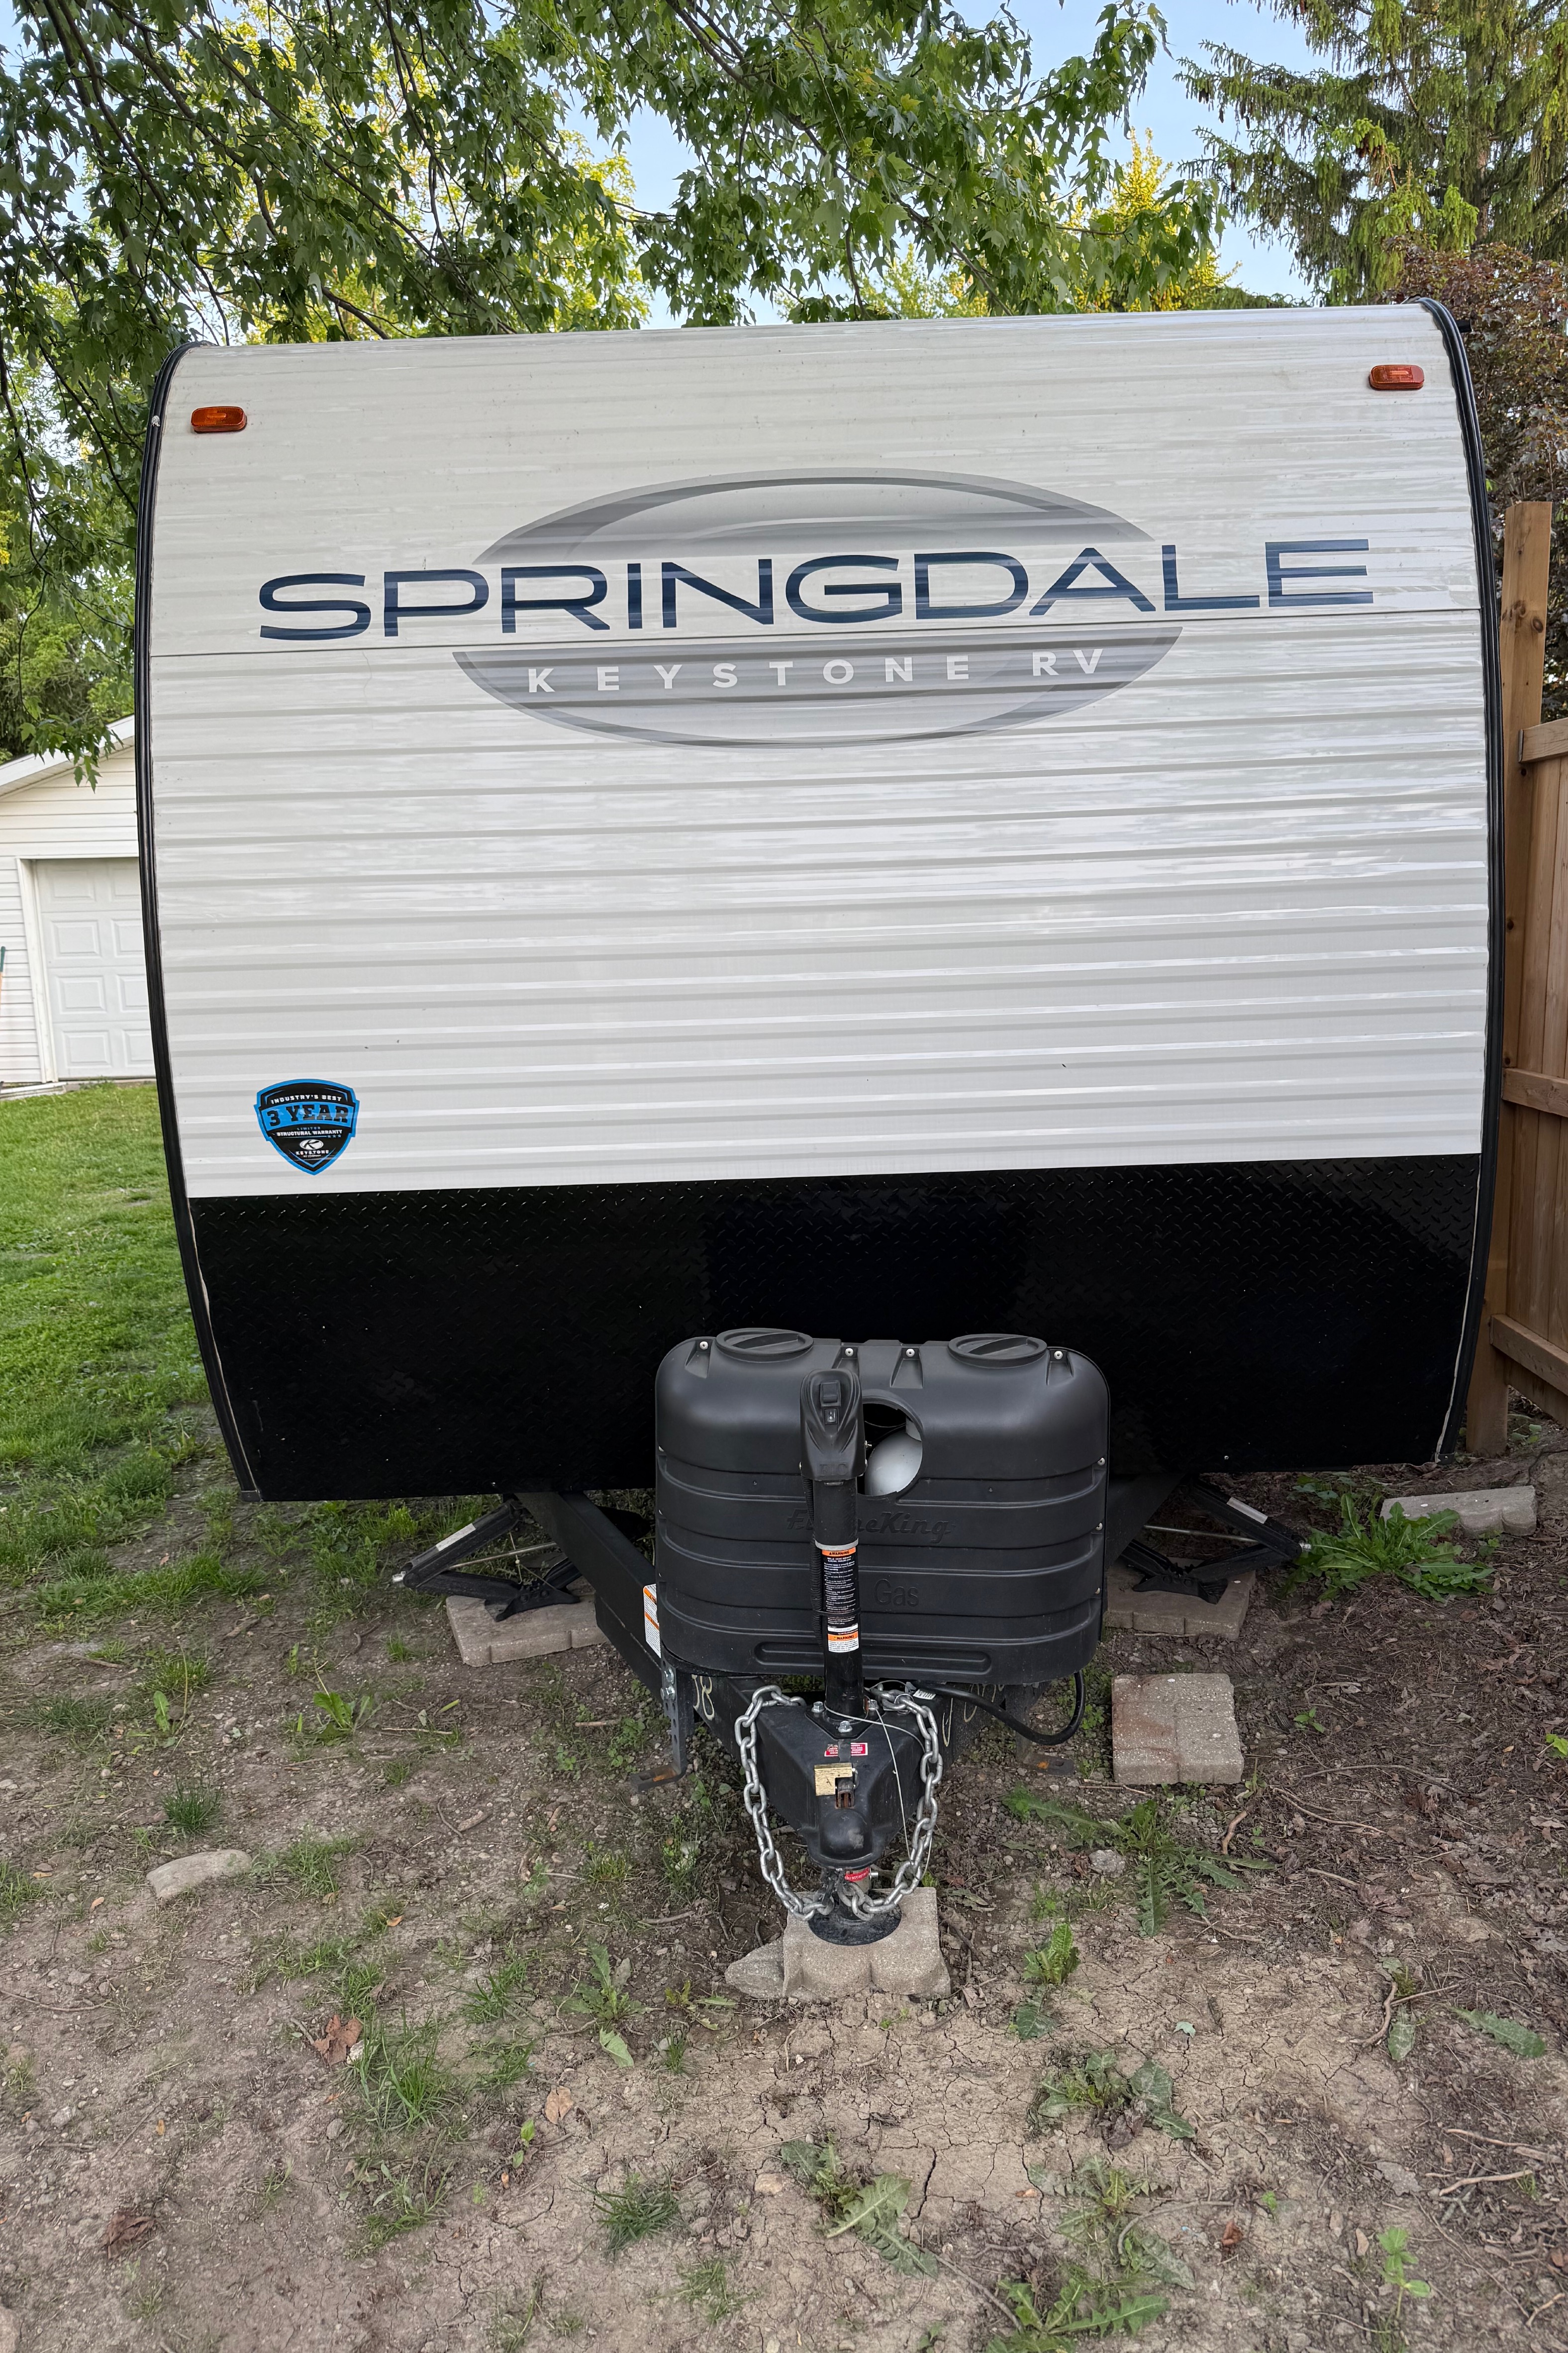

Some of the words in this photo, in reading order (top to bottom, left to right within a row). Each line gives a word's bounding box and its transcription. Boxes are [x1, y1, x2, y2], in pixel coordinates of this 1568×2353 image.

[259, 538, 1373, 641] SPRINGDALE
[528, 655, 969, 693] KEYSTONE
[1032, 648, 1103, 676] RV
[271, 1095, 319, 1104] INDUSTRY'S
[267, 1110, 281, 1126] 3
[286, 1104, 348, 1124] YEAR
[874, 1578, 919, 1607] Gas
